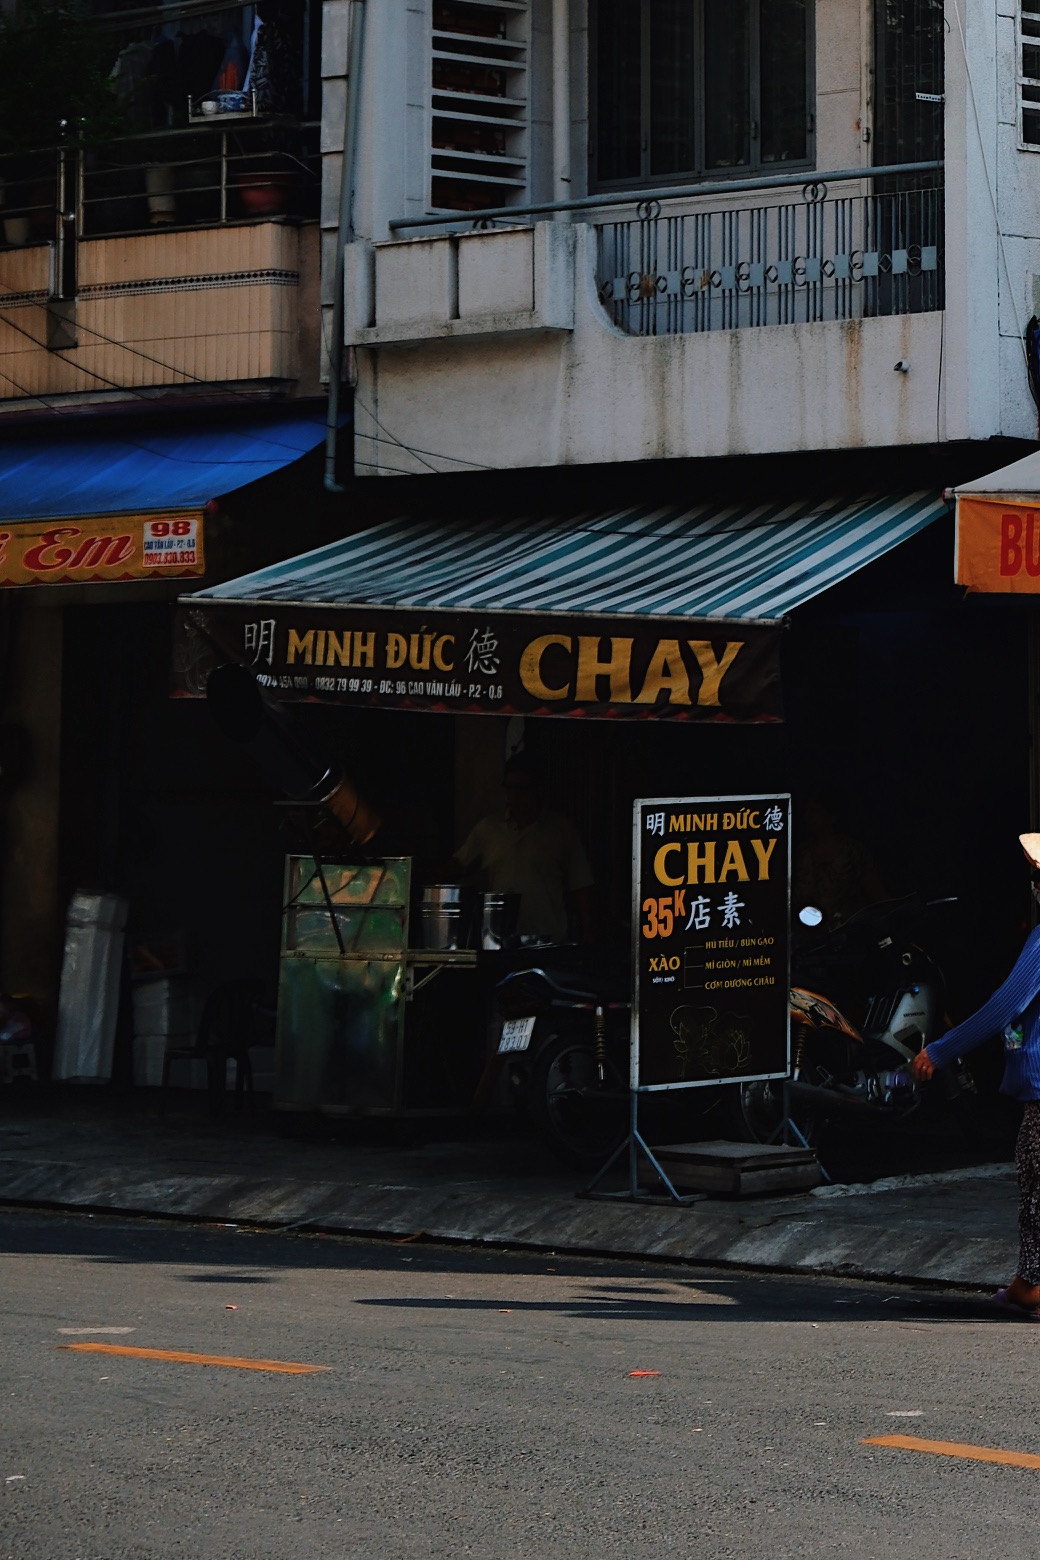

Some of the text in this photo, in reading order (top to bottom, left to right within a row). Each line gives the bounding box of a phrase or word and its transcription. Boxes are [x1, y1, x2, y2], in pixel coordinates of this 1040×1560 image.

[151, 521, 190, 537] 98
[244, 618, 276, 667] 明
[286, 625, 456, 672] MINH ĐỨC
[464, 626, 501, 675] 德
[519, 634, 745, 706] CHAY
[315, 677, 335, 691] 0832
[337, 678, 347, 691] 79
[396, 681, 406, 694] 96
[408, 681, 424, 695] CAO
[468, 684, 481, 697] P.2
[488, 685, 503, 699] Q.6
[646, 812, 665, 837] 明
[669, 807, 761, 833] MINH ĐỨC
[763, 805, 784, 832] 德
[654, 838, 777, 887] CHAY
[642, 889, 686, 939] 35K
[757, 937, 775, 947] GẠO
[648, 953, 681, 972] XÀO
